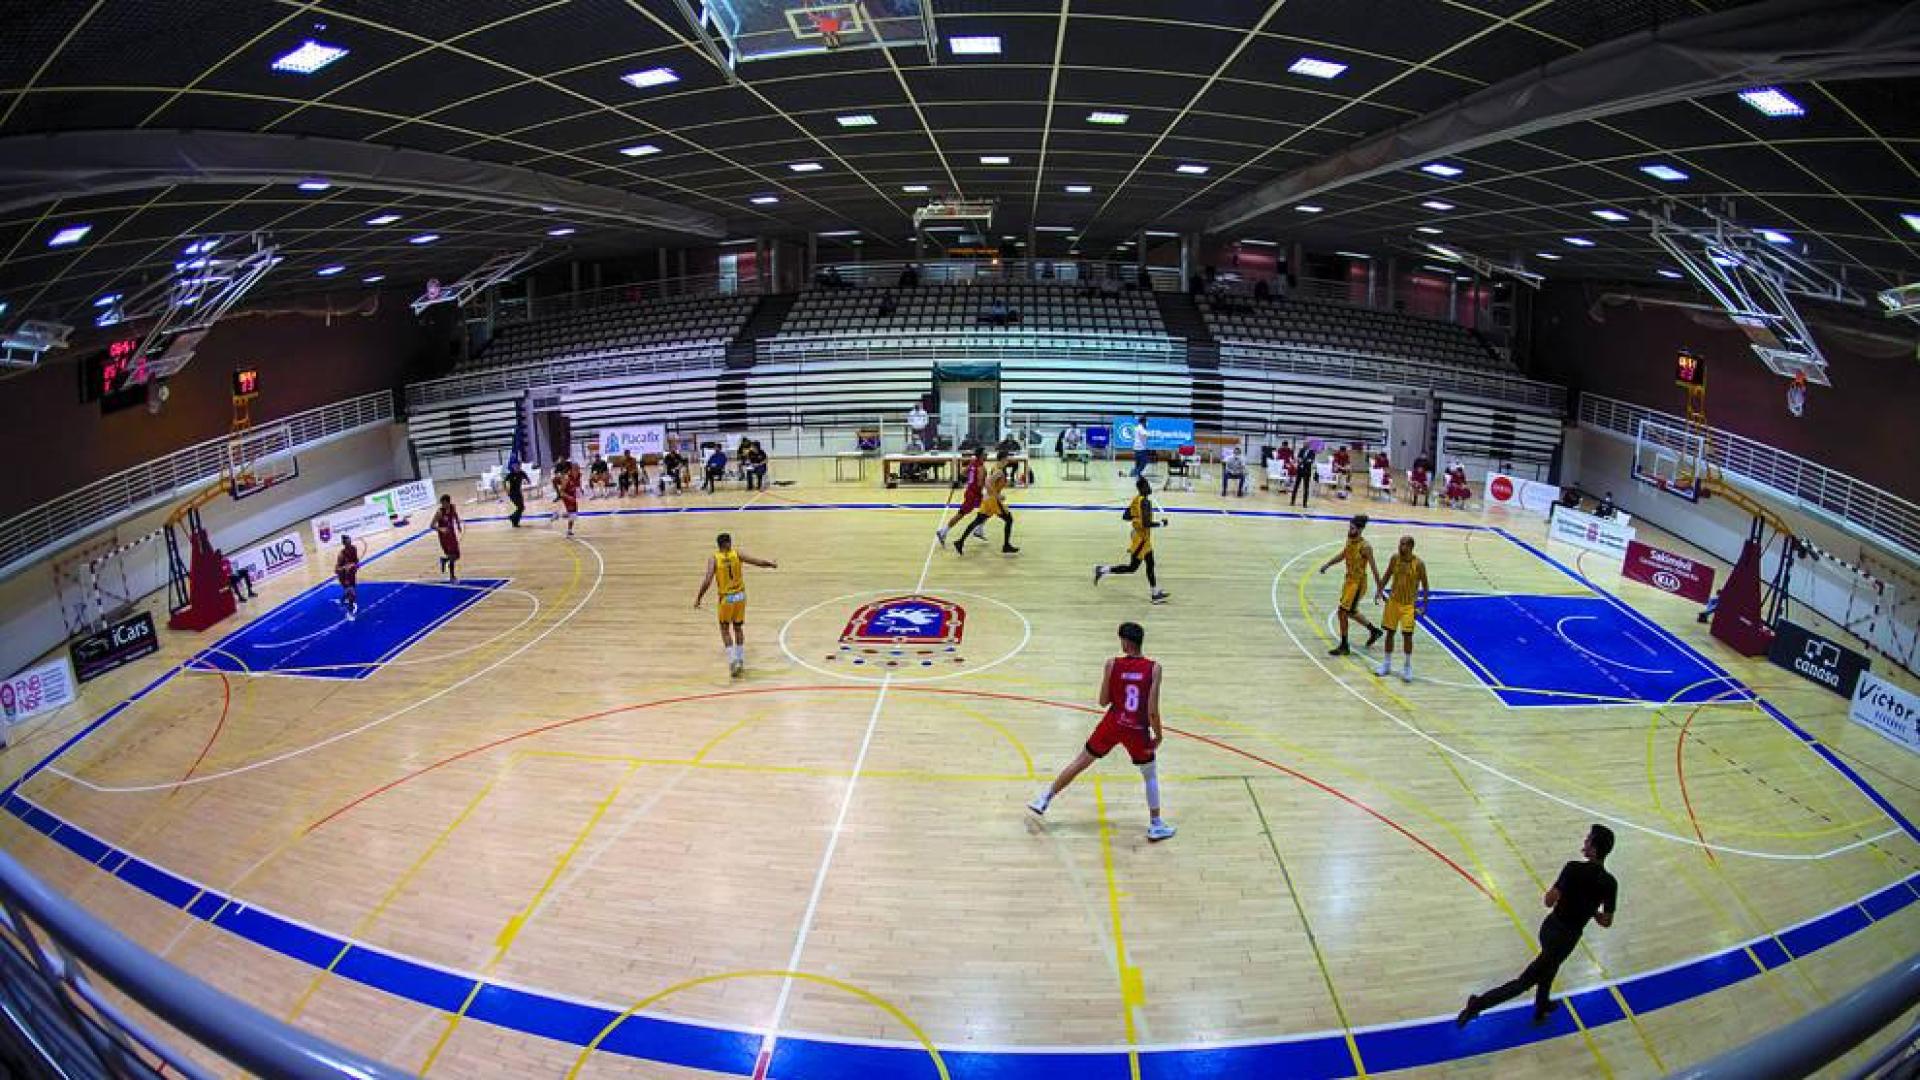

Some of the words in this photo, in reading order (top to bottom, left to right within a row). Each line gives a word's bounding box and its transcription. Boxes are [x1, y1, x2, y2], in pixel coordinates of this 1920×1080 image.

[262, 539, 303, 567] IMQ
[112, 620, 149, 647] iCars
[1795, 657, 1840, 687] canasa
[1125, 683, 1140, 712] 8
[1859, 678, 1915, 720] Victor
